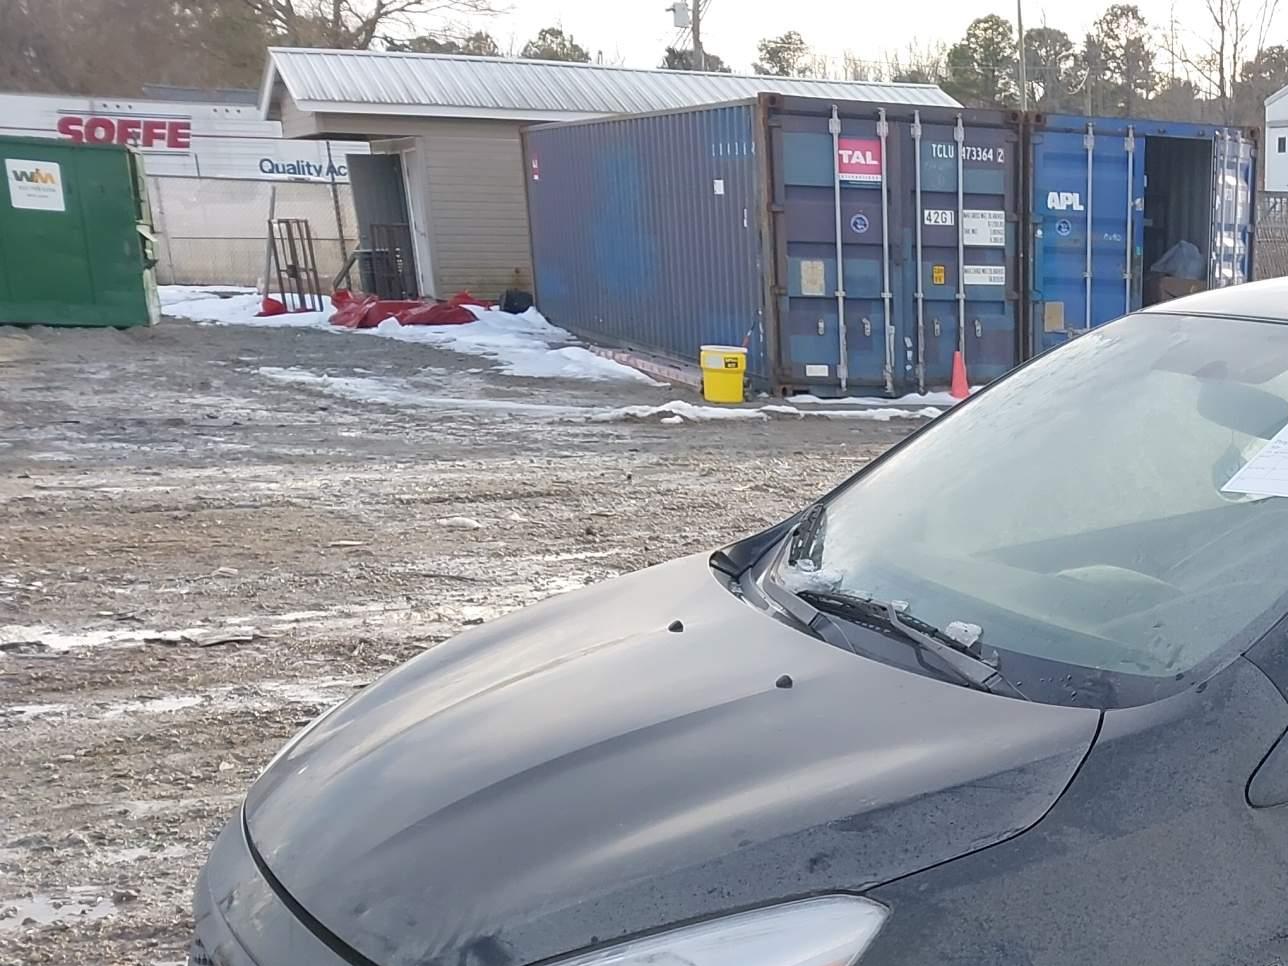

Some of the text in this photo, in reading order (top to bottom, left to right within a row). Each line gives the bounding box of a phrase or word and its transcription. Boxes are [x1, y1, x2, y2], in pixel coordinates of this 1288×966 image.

[57, 116, 192, 149] SOFFE
[838, 149, 880, 166] TAL
[931, 143, 955, 158] TCLU
[996, 147, 1005, 163] 2
[259, 158, 322, 177] Quality
[1047, 191, 1084, 211] APL
[926, 211, 953, 225] 42G1
